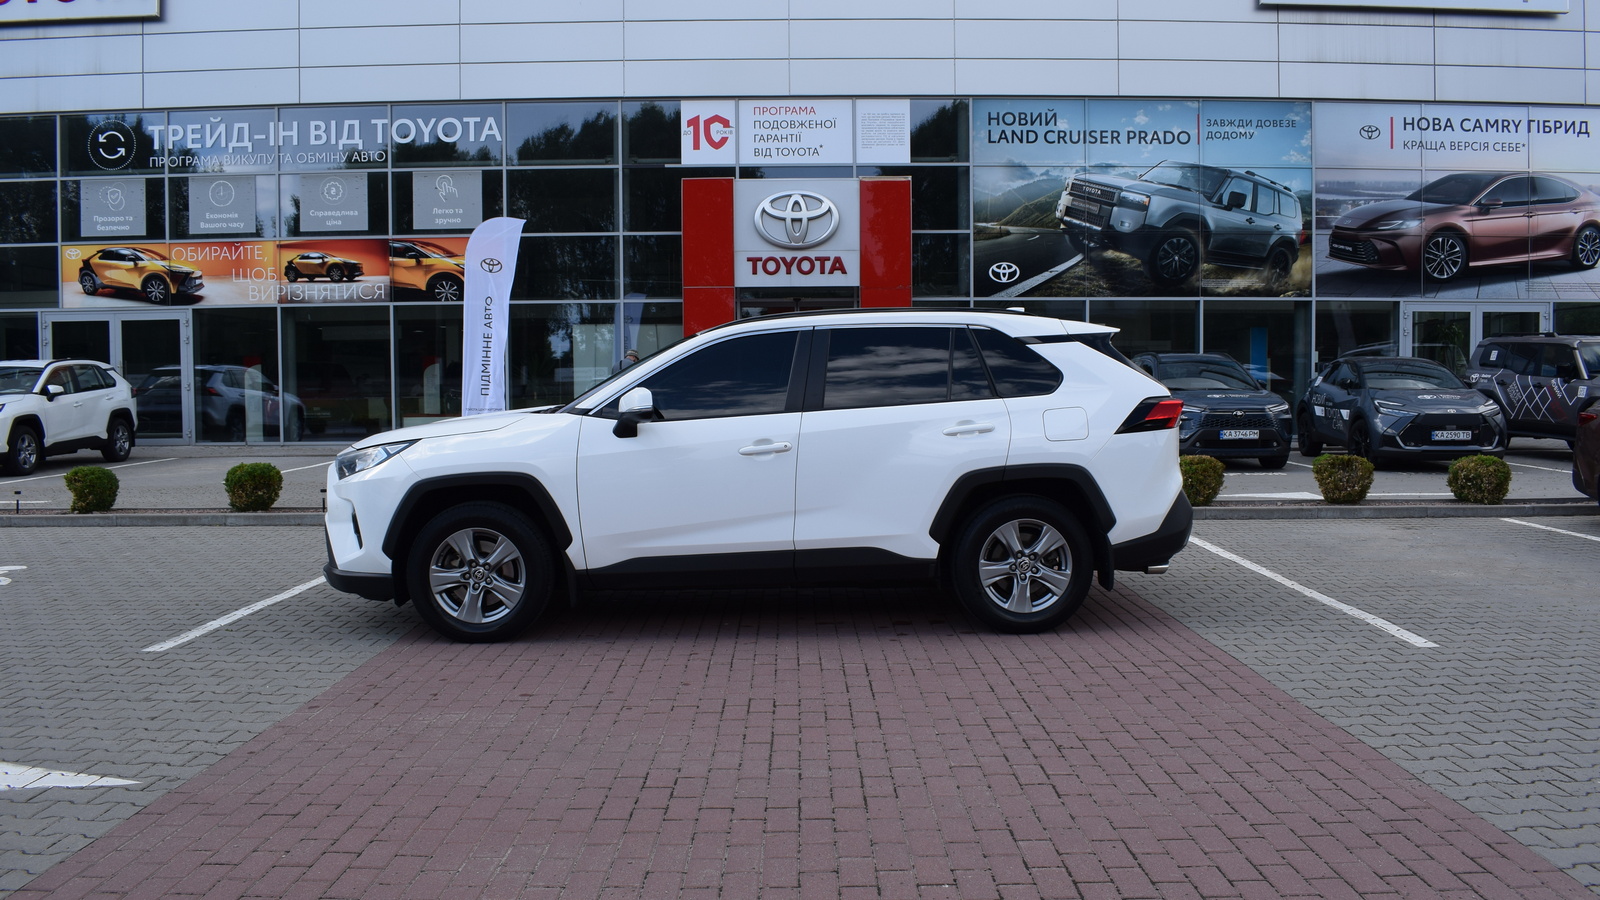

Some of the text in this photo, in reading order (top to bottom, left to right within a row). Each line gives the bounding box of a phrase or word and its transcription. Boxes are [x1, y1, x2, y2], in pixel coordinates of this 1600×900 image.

[753, 106, 816, 116] ПРОГРАМА
[987, 108, 1058, 127] НОВИЙ
[1205, 118, 1297, 129] ЗАВЖДИ ДОВЕЗЕ
[753, 117, 838, 131] ПОДОВЖЕНОЇ
[1403, 117, 1590, 138] НОВА CAMRY ГІБРИД
[148, 116, 502, 153] ТРЕЙД-ІН ВІД TOYOTA
[753, 131, 802, 143] ГАРАНТІЇ
[987, 129, 1191, 145] LAND CRUISER PRADO
[1205, 131, 1255, 141] ДОДОМУ
[1403, 140, 1446, 152] КРАЩА
[1450, 141, 1489, 152] ВЕРСІЯ
[149, 150, 386, 168] ПРОГРАМА ВИКУПУ ТА ОБМІНУ АВТО
[753, 147, 773, 159] ВІД
[309, 209, 359, 218] Справедлива
[432, 207, 454, 215] Легко
[93, 215, 124, 224] Прозоро
[200, 221, 226, 229] Вашого
[325, 218, 342, 226] ціна
[434, 217, 462, 225] зручно
[96, 223, 130, 231] безпечно
[171, 243, 268, 262] ОБИРАЙТЕ,
[746, 256, 848, 276] TOYOTA
[232, 267, 277, 284] ЩОБ
[249, 283, 385, 302] ВИРІЗНЯТИСЯ
[480, 296, 493, 396] ПІДМІННЕ АВТО
[1446, 431, 1461, 439] 2590
